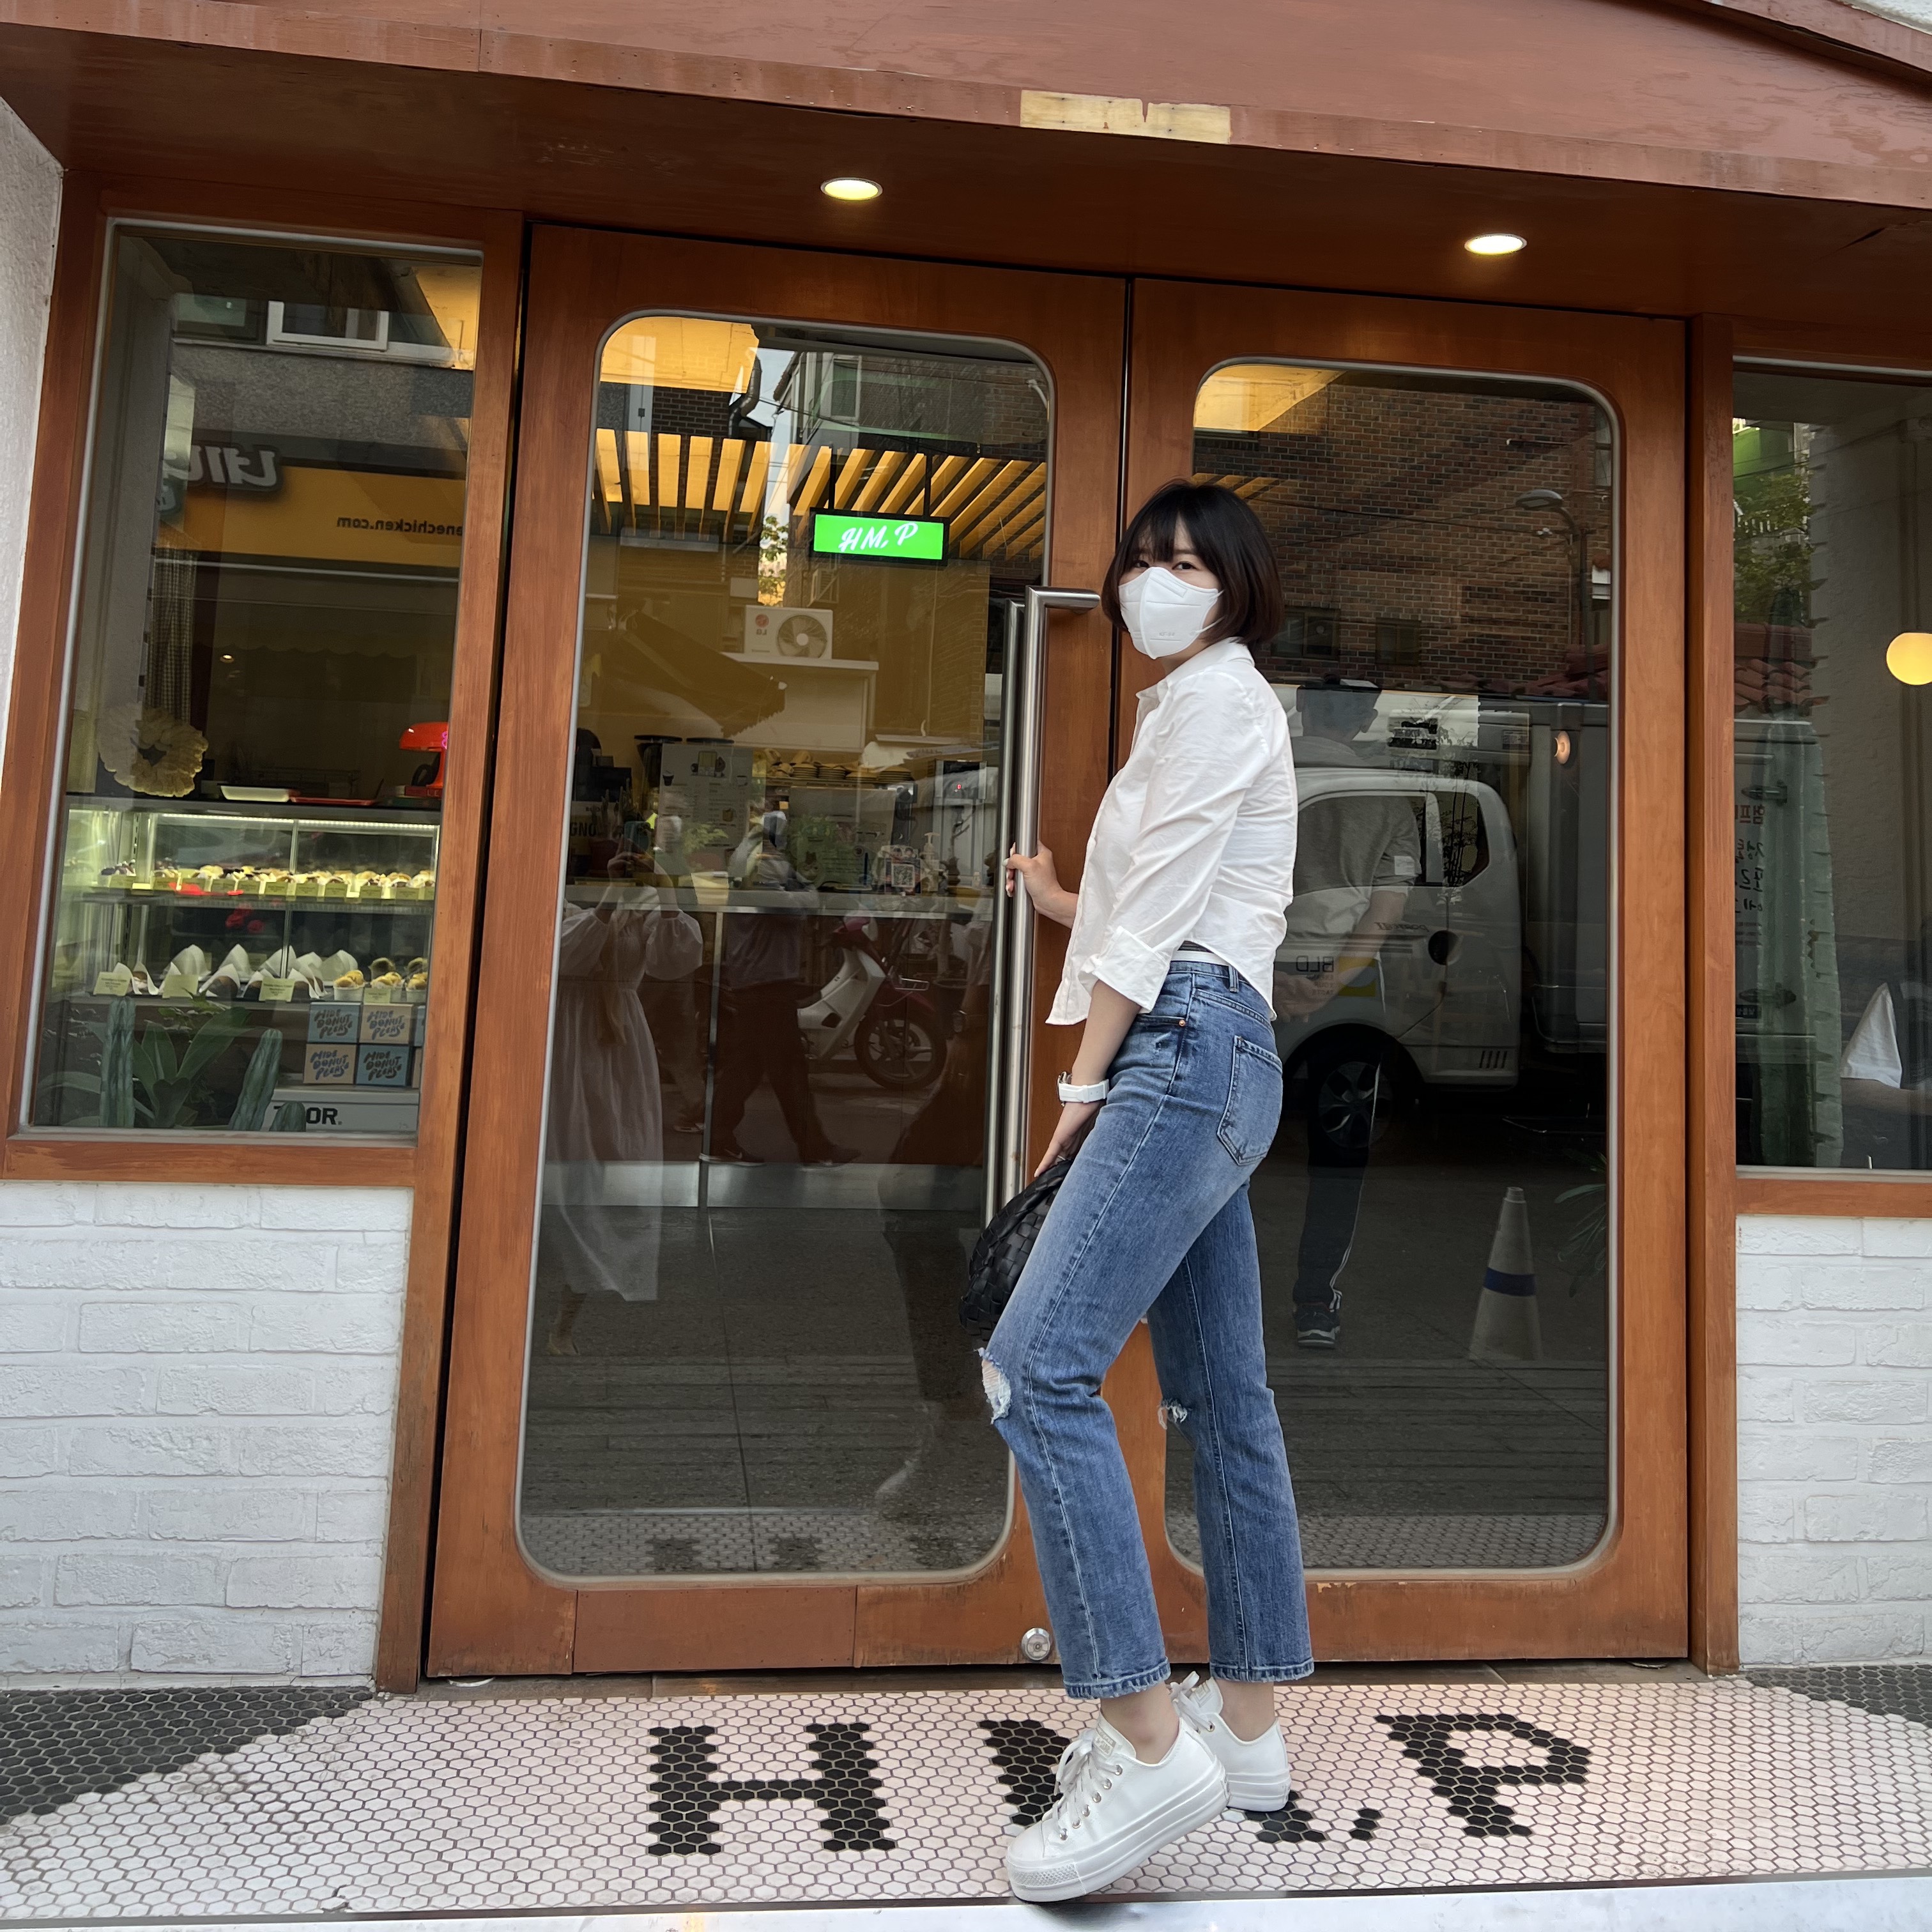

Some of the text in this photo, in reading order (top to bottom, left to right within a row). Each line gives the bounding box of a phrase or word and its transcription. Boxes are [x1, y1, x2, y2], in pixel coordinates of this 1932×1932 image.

[317, 1014, 352, 1029] DONUT
[369, 1015, 405, 1029] DONUT
[312, 1055, 349, 1070] DONUT
[366, 1056, 402, 1070] DONUT
